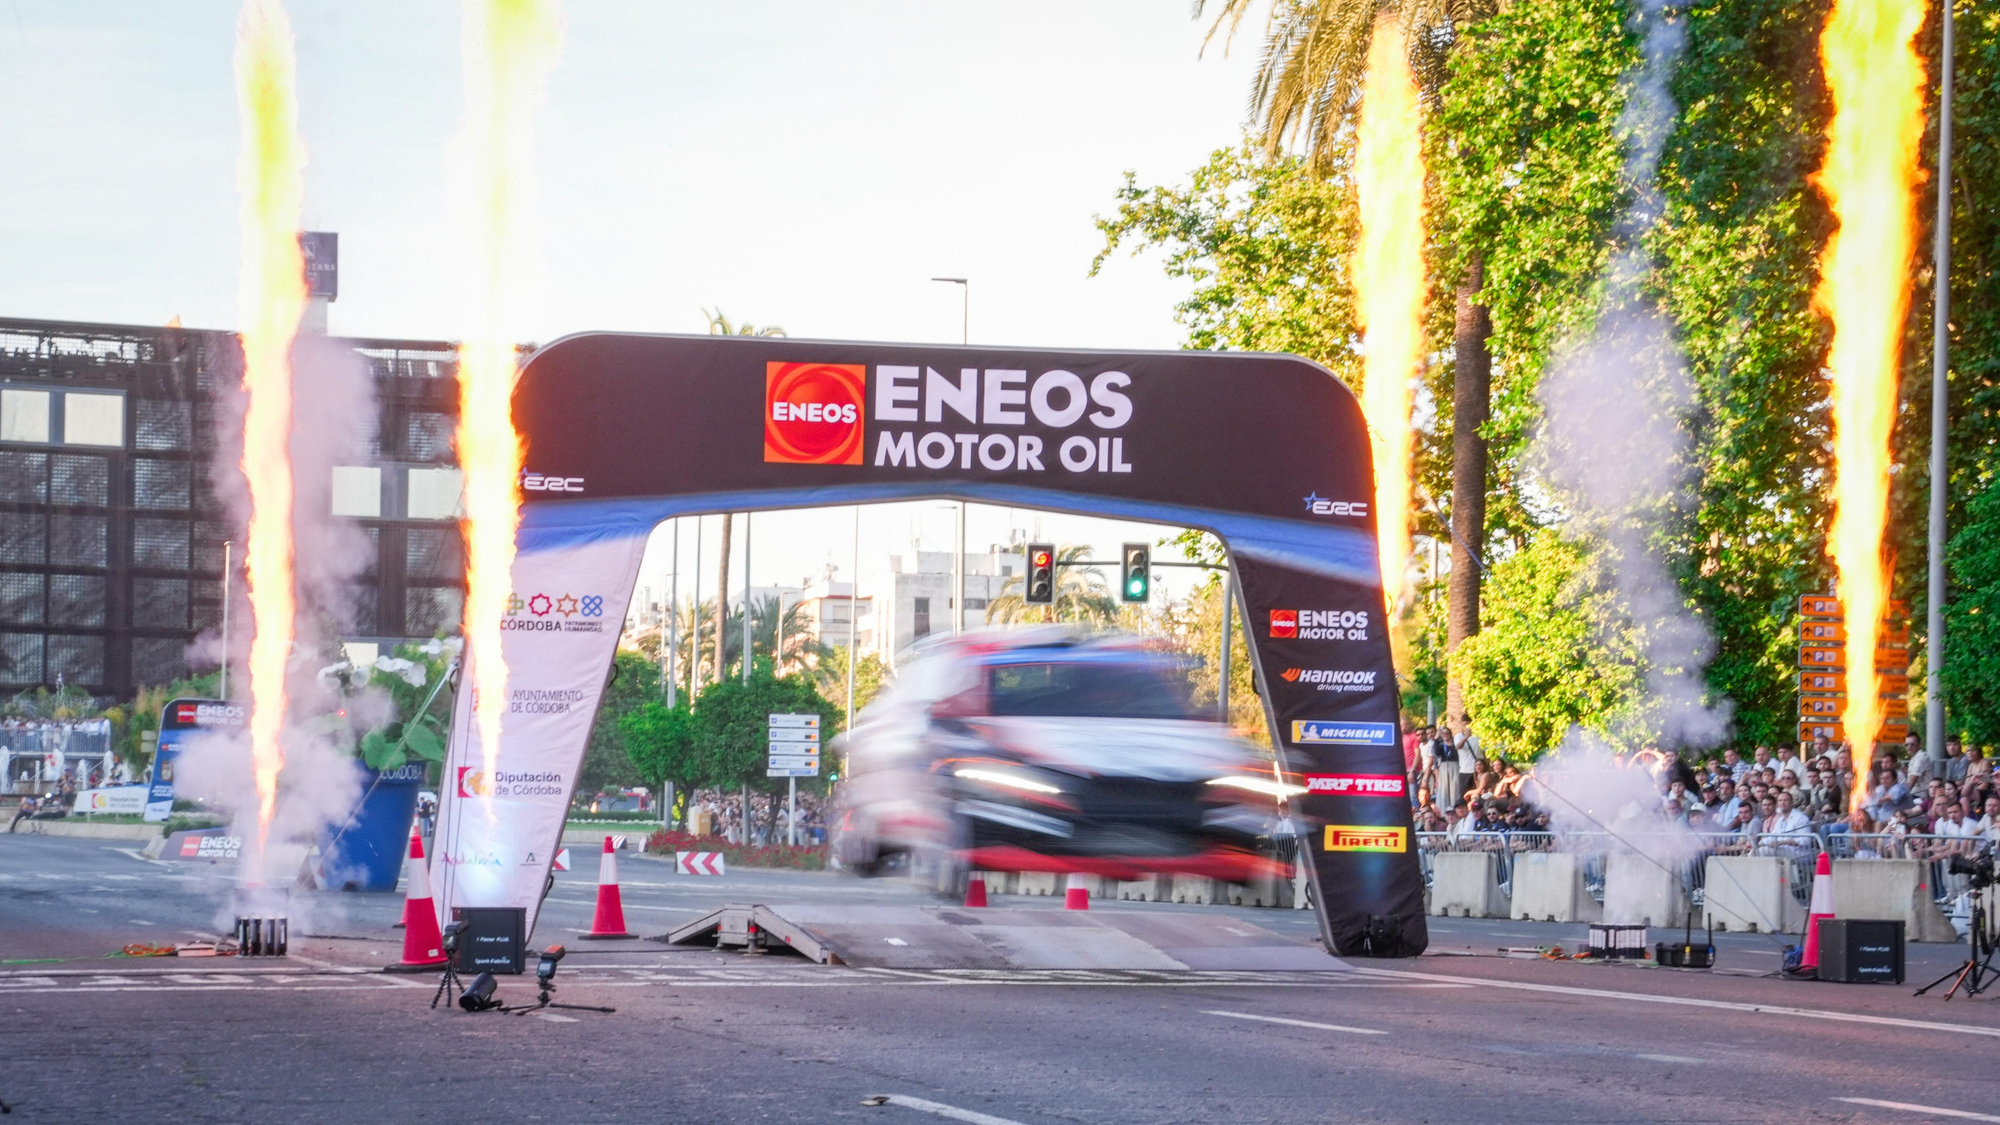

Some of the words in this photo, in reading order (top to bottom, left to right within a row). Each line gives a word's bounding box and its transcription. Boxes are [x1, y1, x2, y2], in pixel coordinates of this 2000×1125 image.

[875, 364, 1133, 429] ENEOS
[772, 402, 857, 424] ENEOS
[874, 430, 1045, 471] MOTOR
[1059, 435, 1132, 473] OIL
[500, 618, 562, 632] CÓRDOBA
[1299, 610, 1368, 628] ENEOS
[1299, 628, 1345, 640] MOTOR
[1347, 629, 1368, 641] OIL
[1317, 683, 1342, 692] driving
[512, 690, 583, 701] AYUNTAMIENTO
[196, 704, 244, 718] ENEOS
[511, 702, 523, 713] DE
[525, 700, 571, 714] CÓRDOBA
[1320, 728, 1385, 739] MICHELIN
[495, 771, 561, 783] Diputación
[495, 785, 509, 795] de
[513, 784, 562, 795] Córdoba
[1307, 777, 1353, 791] MRF
[1355, 779, 1402, 792] TYRES
[199, 836, 241, 849] ENEOS
[1332, 830, 1399, 847] PIRELLI
[196, 849, 224, 857] MOTOR
